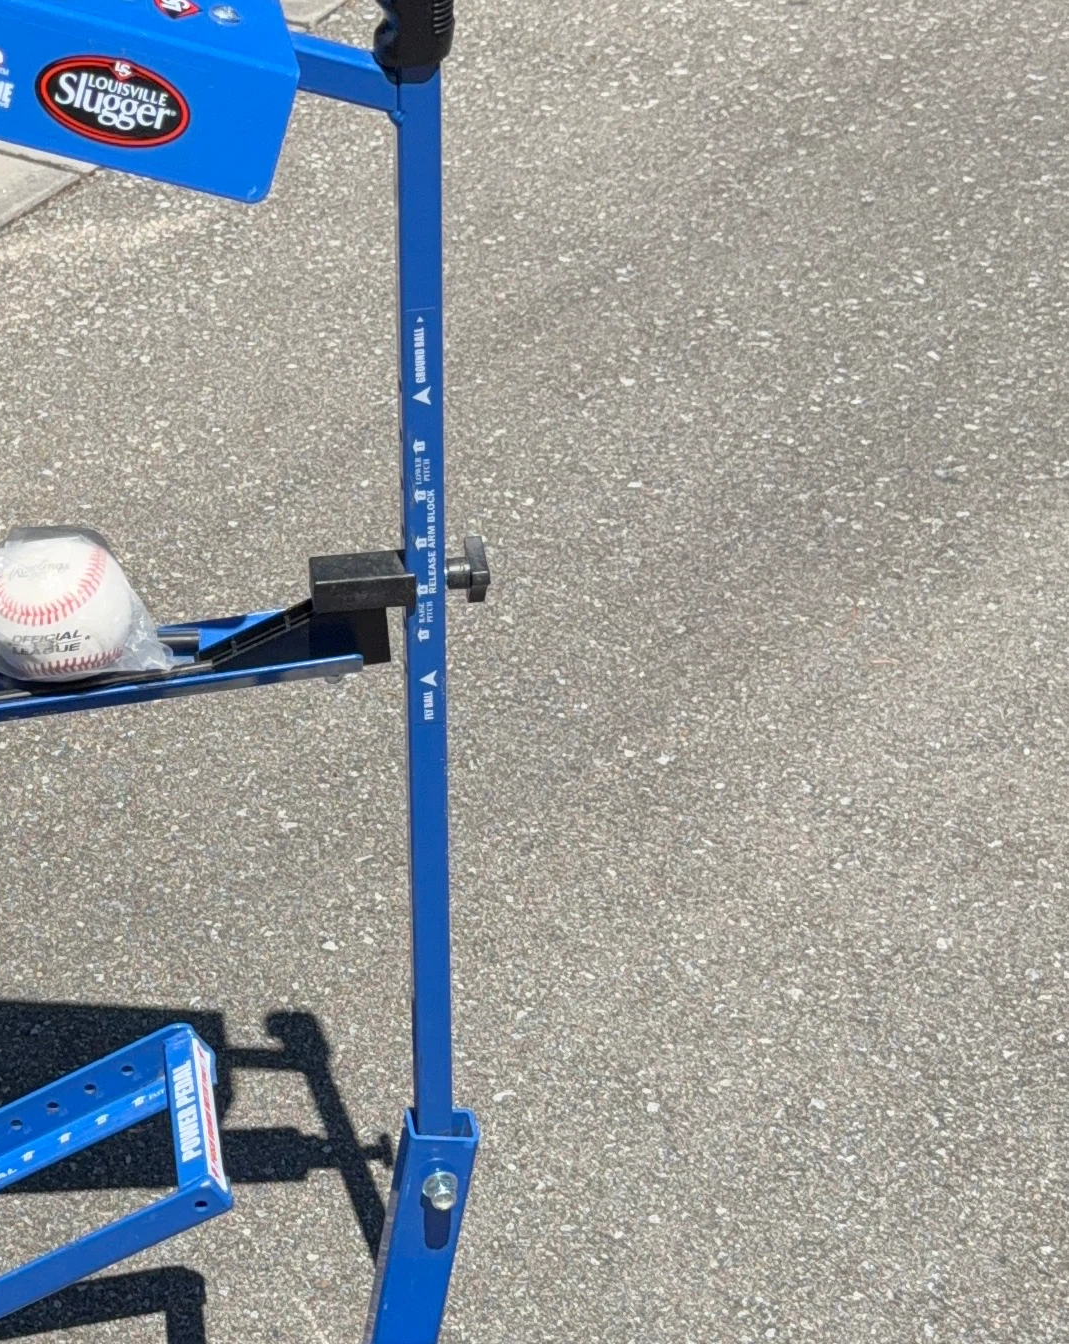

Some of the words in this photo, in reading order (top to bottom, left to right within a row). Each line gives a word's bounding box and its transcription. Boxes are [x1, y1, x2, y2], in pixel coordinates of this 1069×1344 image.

[54, 72, 171, 131] Slugger
[87, 74, 169, 107] LOUISVILLE
[413, 327, 425, 348] BALL
[415, 348, 427, 384] GROUND
[414, 456, 423, 486] LOWER
[422, 458, 431, 482] PITCH
[426, 489, 436, 523] BLOCK
[427, 525, 436, 549] ARM
[426, 551, 437, 594] RELEASE
[418, 602, 426, 623] RAISE
[425, 601, 434, 623] PITCH
[12, 629, 83, 644] OFFICIAL
[12, 642, 82, 656] LEAGUE
[423, 690, 434, 708] BALL
[424, 709, 435, 720] FLY
[172, 1060, 196, 1109] PEDAL
[176, 1104, 202, 1163] POWER
